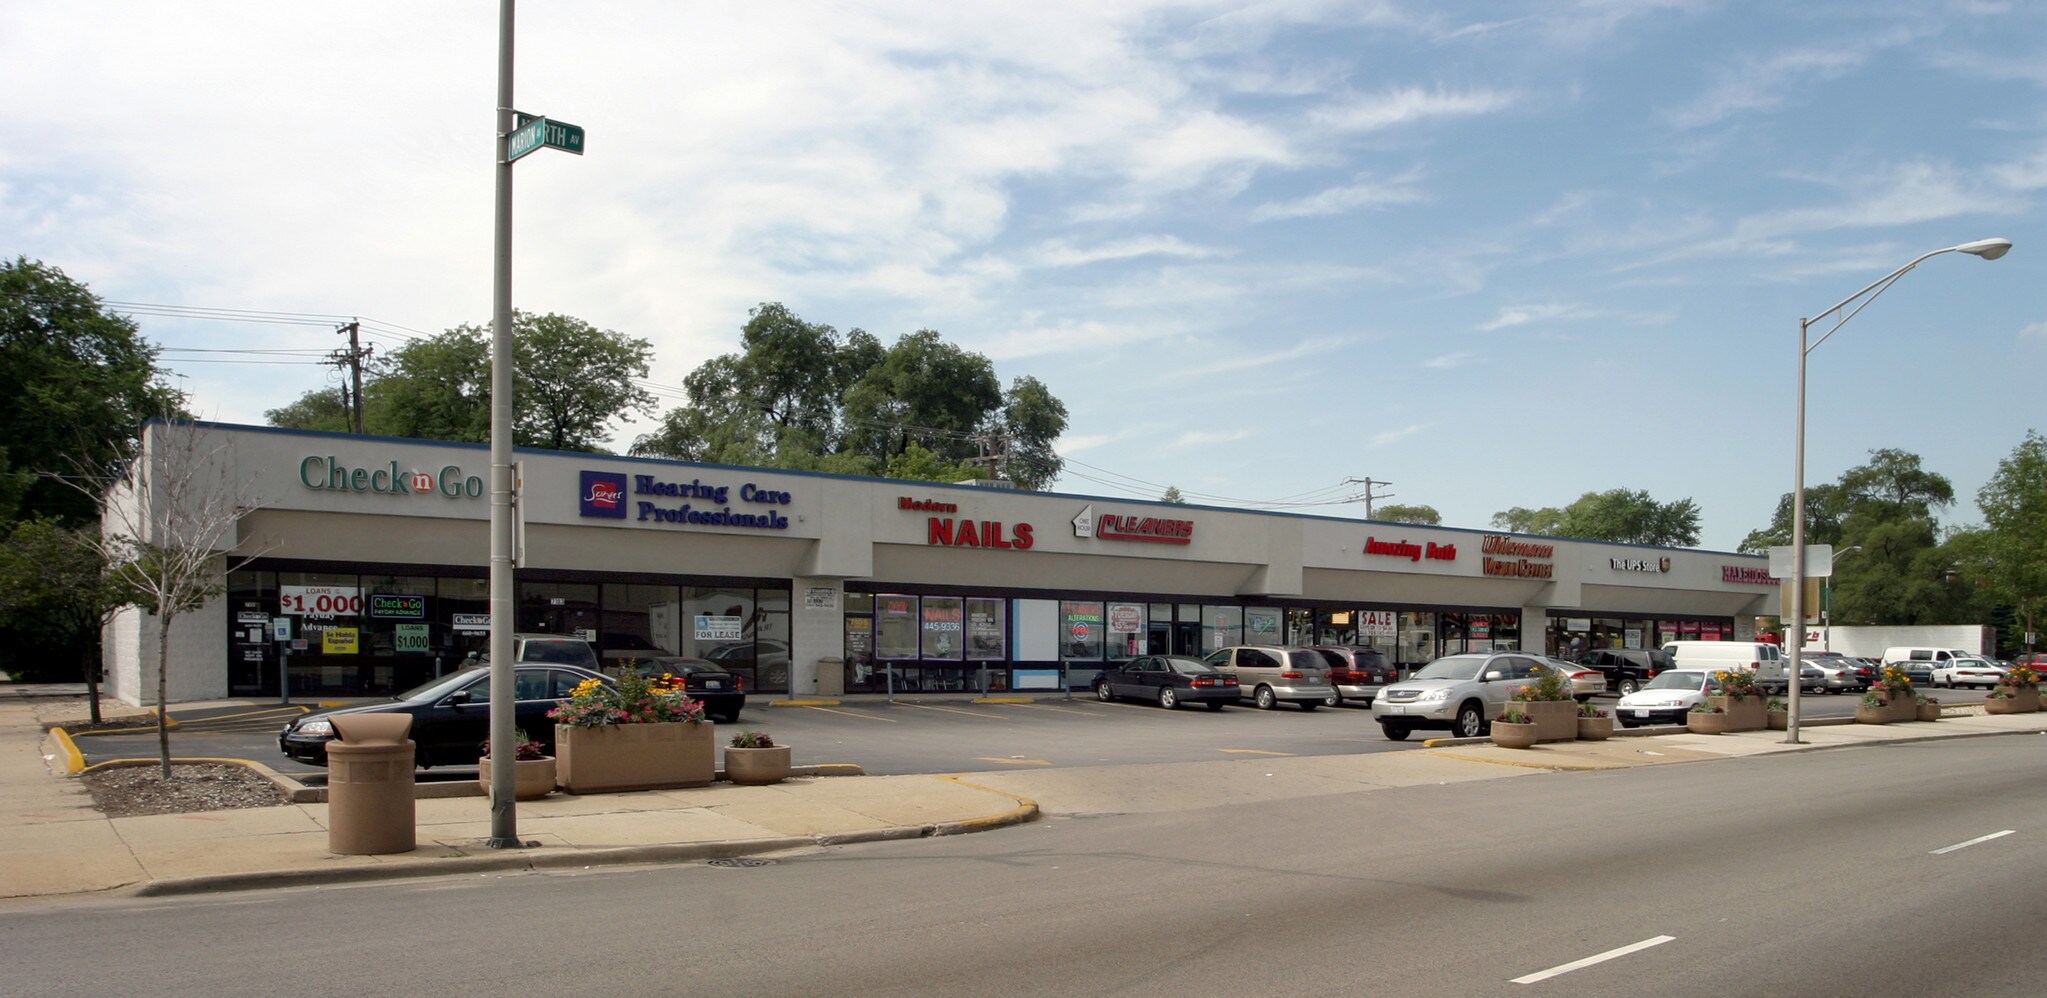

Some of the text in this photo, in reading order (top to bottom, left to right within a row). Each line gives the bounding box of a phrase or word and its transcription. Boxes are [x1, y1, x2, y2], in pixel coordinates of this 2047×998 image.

[511, 126, 535, 156] MARION
[570, 134, 580, 144] AV
[300, 455, 410, 496] Check
[437, 465, 484, 499] Go
[634, 474, 792, 505] Hearing Care
[897, 496, 958, 513] Modern
[636, 501, 789, 530] Professionals
[928, 517, 1035, 550] NAILS
[1097, 514, 1194, 545] CLEANERS
[1363, 536, 1423, 562] Amazing
[1611, 558, 1626, 570] The
[1626, 559, 1641, 571] UPS
[1642, 560, 1660, 573] Store
[281, 593, 364, 613] $1,000
[374, 598, 402, 609] Check
[408, 599, 422, 609] Go
[454, 616, 477, 625] Check
[924, 608, 961, 622] NAILS
[1361, 611, 1392, 625] SALE
[695, 631, 740, 639] FOR LEASE
[924, 622, 960, 632] 445-9336
[397, 636, 428, 648] $1,000
